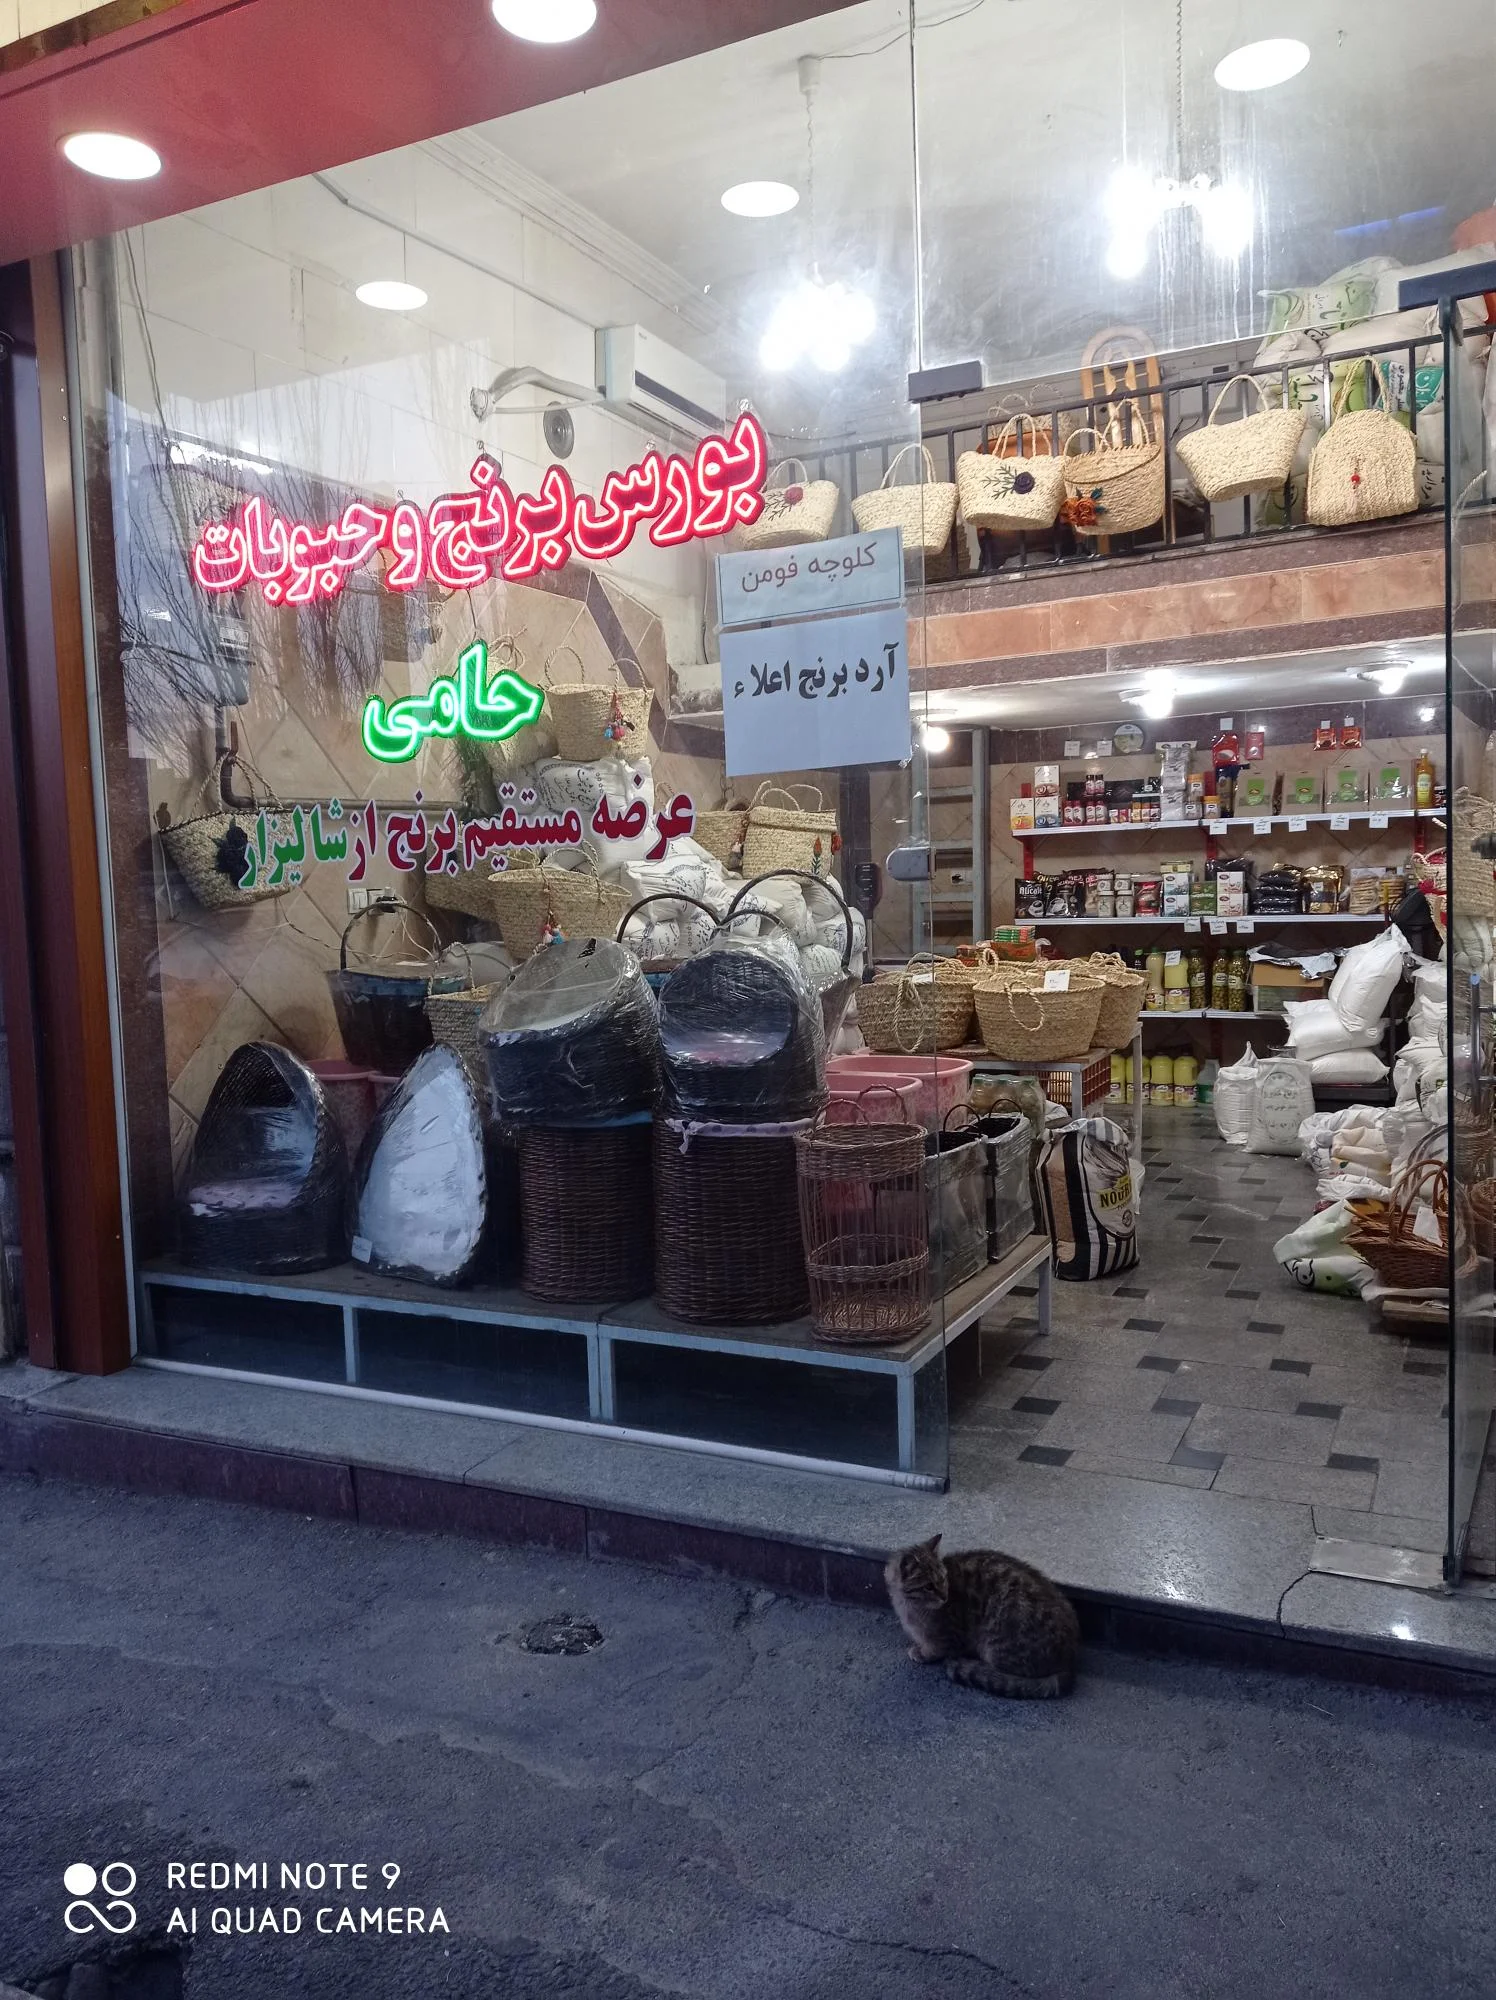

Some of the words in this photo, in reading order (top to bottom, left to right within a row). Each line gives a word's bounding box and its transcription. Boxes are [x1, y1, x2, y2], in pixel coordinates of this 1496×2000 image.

[430, 453, 569, 587] برنج
[575, 412, 768, 557] بورس
[195, 496, 388, 602] حبوبات
[385, 503, 422, 588] و
[741, 554, 799, 593] فومن
[807, 541, 878, 582] کلوچه
[362, 640, 543, 761] حامی
[798, 656, 848, 700] برنج
[855, 641, 900, 692] آرد
[239, 798, 348, 888] شالیزار
[348, 800, 377, 880] از
[387, 789, 459, 876] برنج
[464, 782, 583, 870] مستقیم
[592, 773, 695, 860] عرضه
